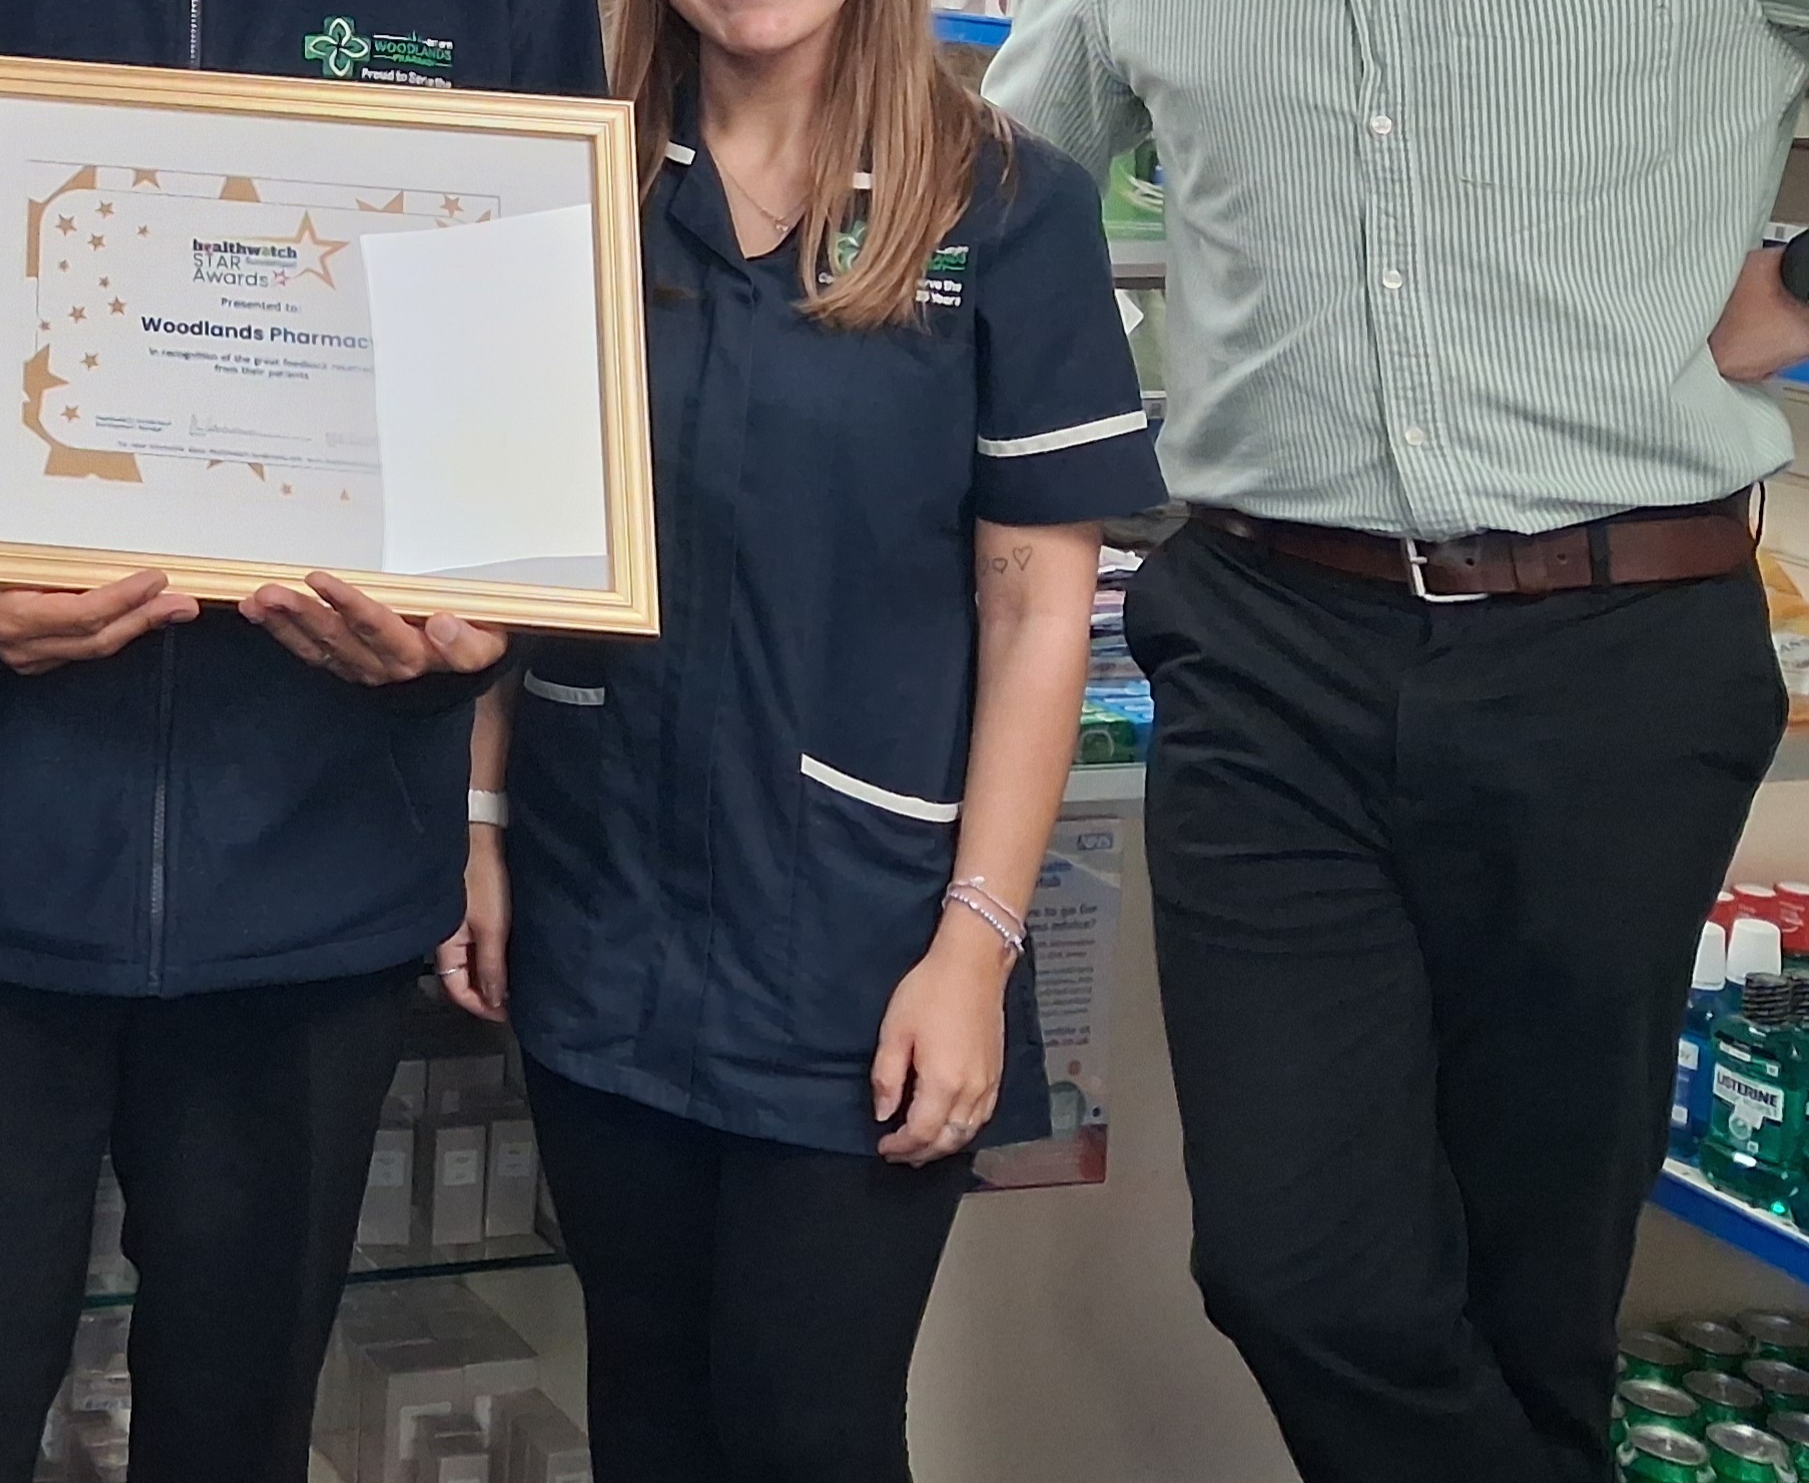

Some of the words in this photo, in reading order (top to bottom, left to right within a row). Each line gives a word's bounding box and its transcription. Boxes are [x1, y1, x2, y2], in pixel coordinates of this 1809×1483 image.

[374, 40, 453, 61] WOODLANDS
[361, 67, 395, 82] Proud
[395, 69, 408, 82] to
[192, 238, 298, 259] healthwatch
[193, 252, 241, 269] STAR
[192, 268, 269, 287] Awards
[221, 297, 282, 313] Presented
[141, 316, 265, 342] Woodlands
[270, 327, 374, 350] Pharmac
[1717, 1070, 1779, 1108] LISTERINE
